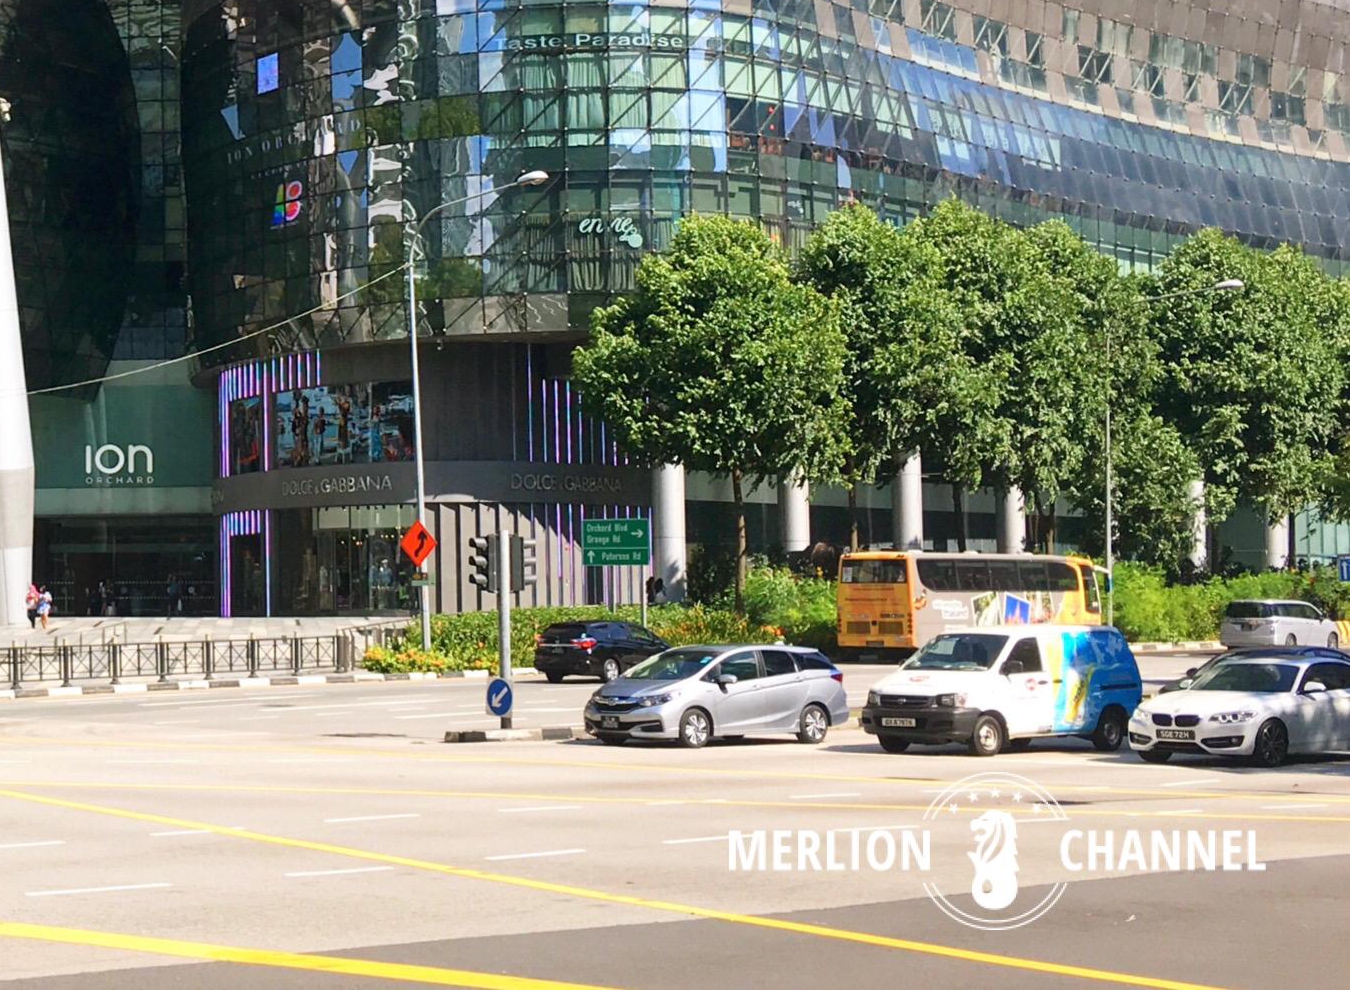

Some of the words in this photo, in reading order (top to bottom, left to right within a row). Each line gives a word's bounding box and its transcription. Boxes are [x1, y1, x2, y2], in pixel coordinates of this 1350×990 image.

[495, 36, 562, 50] Taste
[575, 33, 683, 49] Paradise
[85, 476, 154, 485] ORCHARD
[586, 523, 611, 532] Orchard
